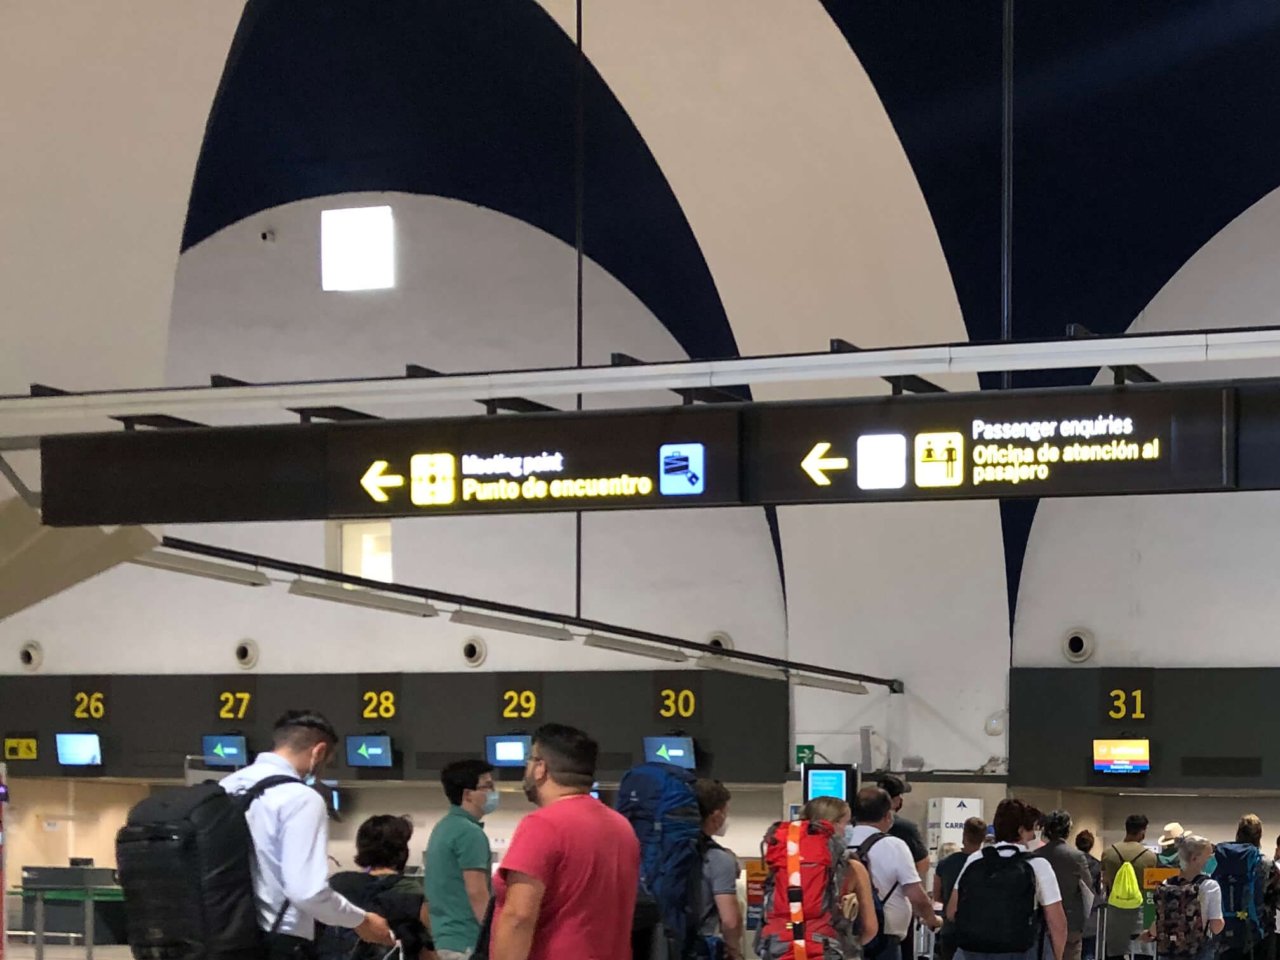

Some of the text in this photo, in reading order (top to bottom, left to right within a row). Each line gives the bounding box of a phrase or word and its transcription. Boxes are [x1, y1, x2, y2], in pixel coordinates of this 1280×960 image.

[972, 413, 1133, 442] Passenger enquiries
[972, 437, 1160, 465] Oficina de atención al
[462, 473, 652, 501] Punto de encuentro
[972, 461, 1049, 486] pasajero
[75, 692, 104, 719] 26
[219, 691, 251, 719] 27
[362, 691, 396, 719] 28
[503, 690, 537, 718] 29
[659, 689, 695, 718] 30
[1108, 689, 1145, 719] 31
